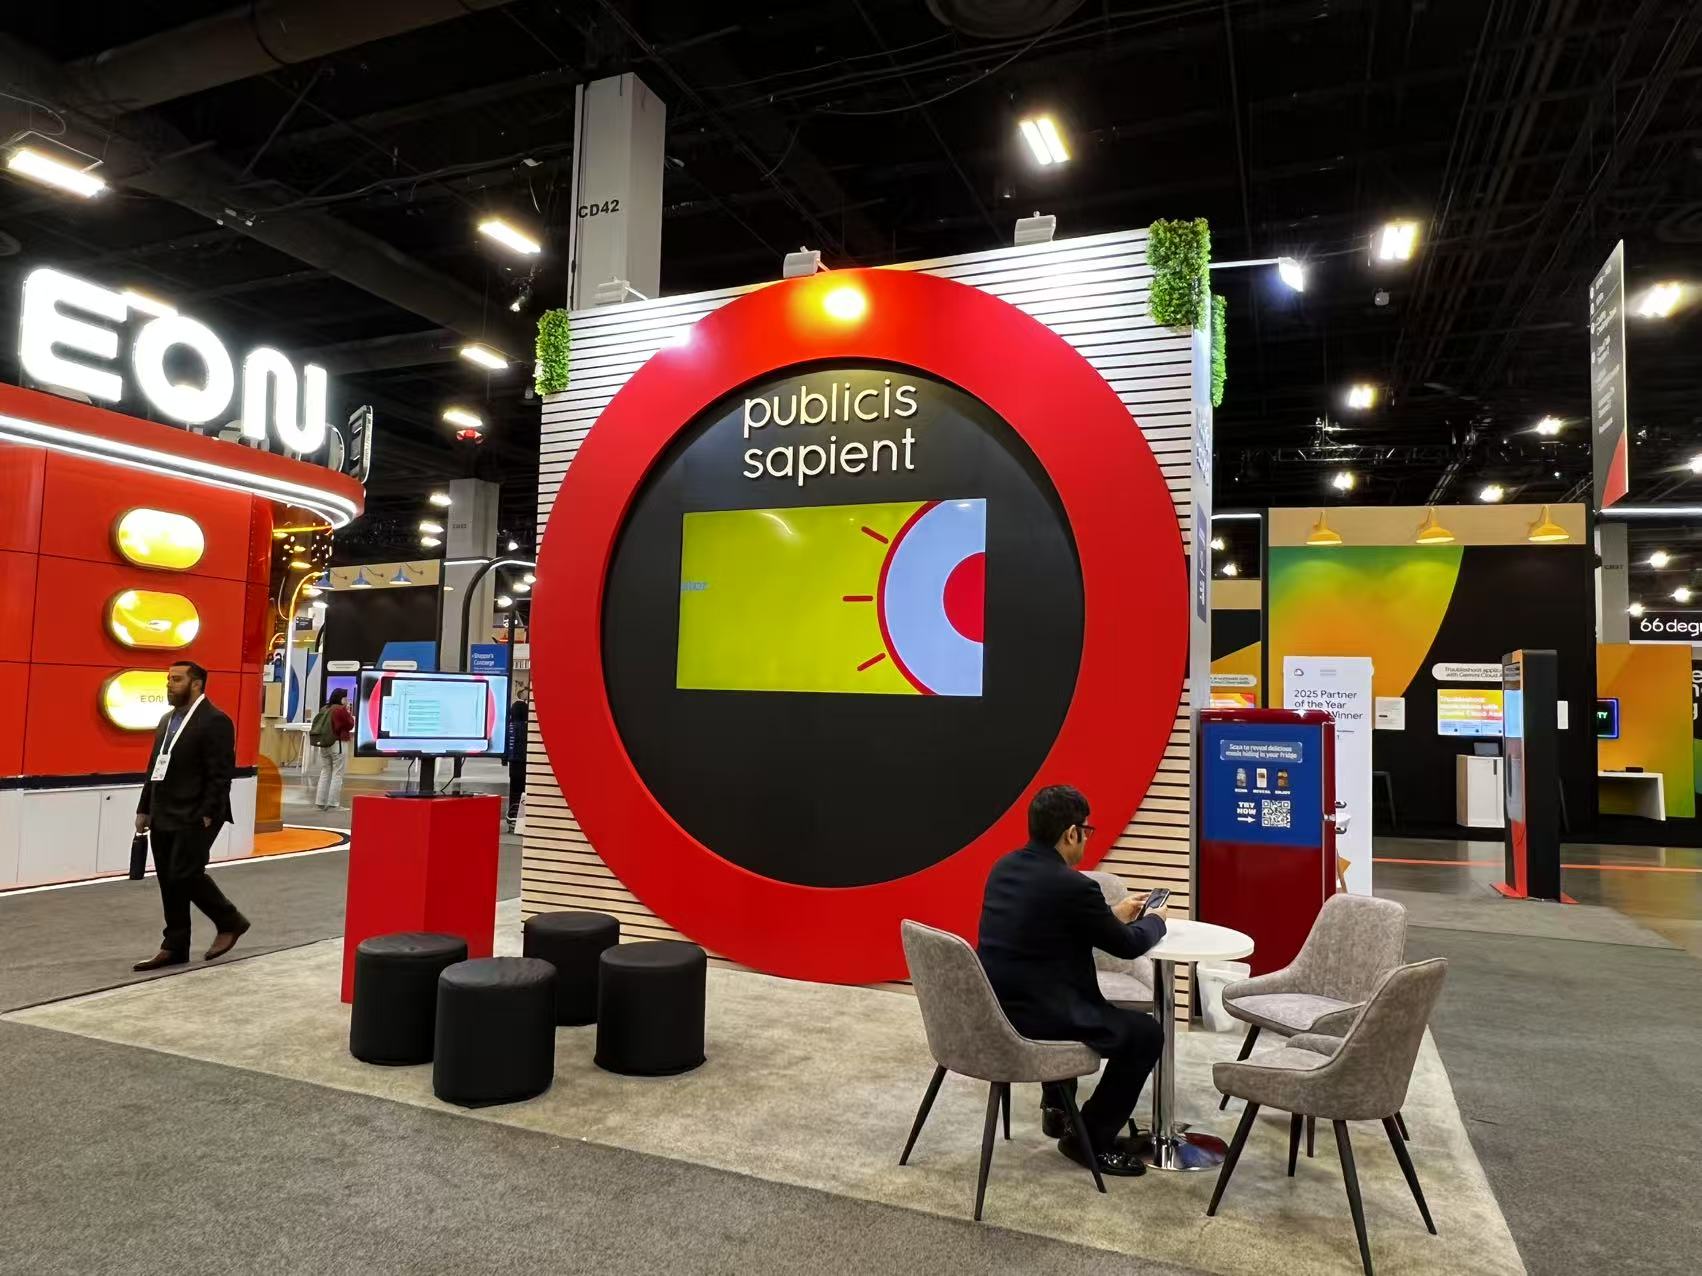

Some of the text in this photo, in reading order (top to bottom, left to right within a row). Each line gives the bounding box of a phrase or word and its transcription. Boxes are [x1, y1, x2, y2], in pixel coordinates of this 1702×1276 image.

[579, 199, 620, 219] CD42
[20, 267, 328, 454] EON
[743, 378, 918, 438] publicis
[743, 427, 916, 486] sapient
[1640, 617, 1664, 632] 66
[1294, 689, 1357, 699] 2025 Partner
[1294, 699, 1347, 709] of the Year
[1597, 711, 1608, 719] TY
